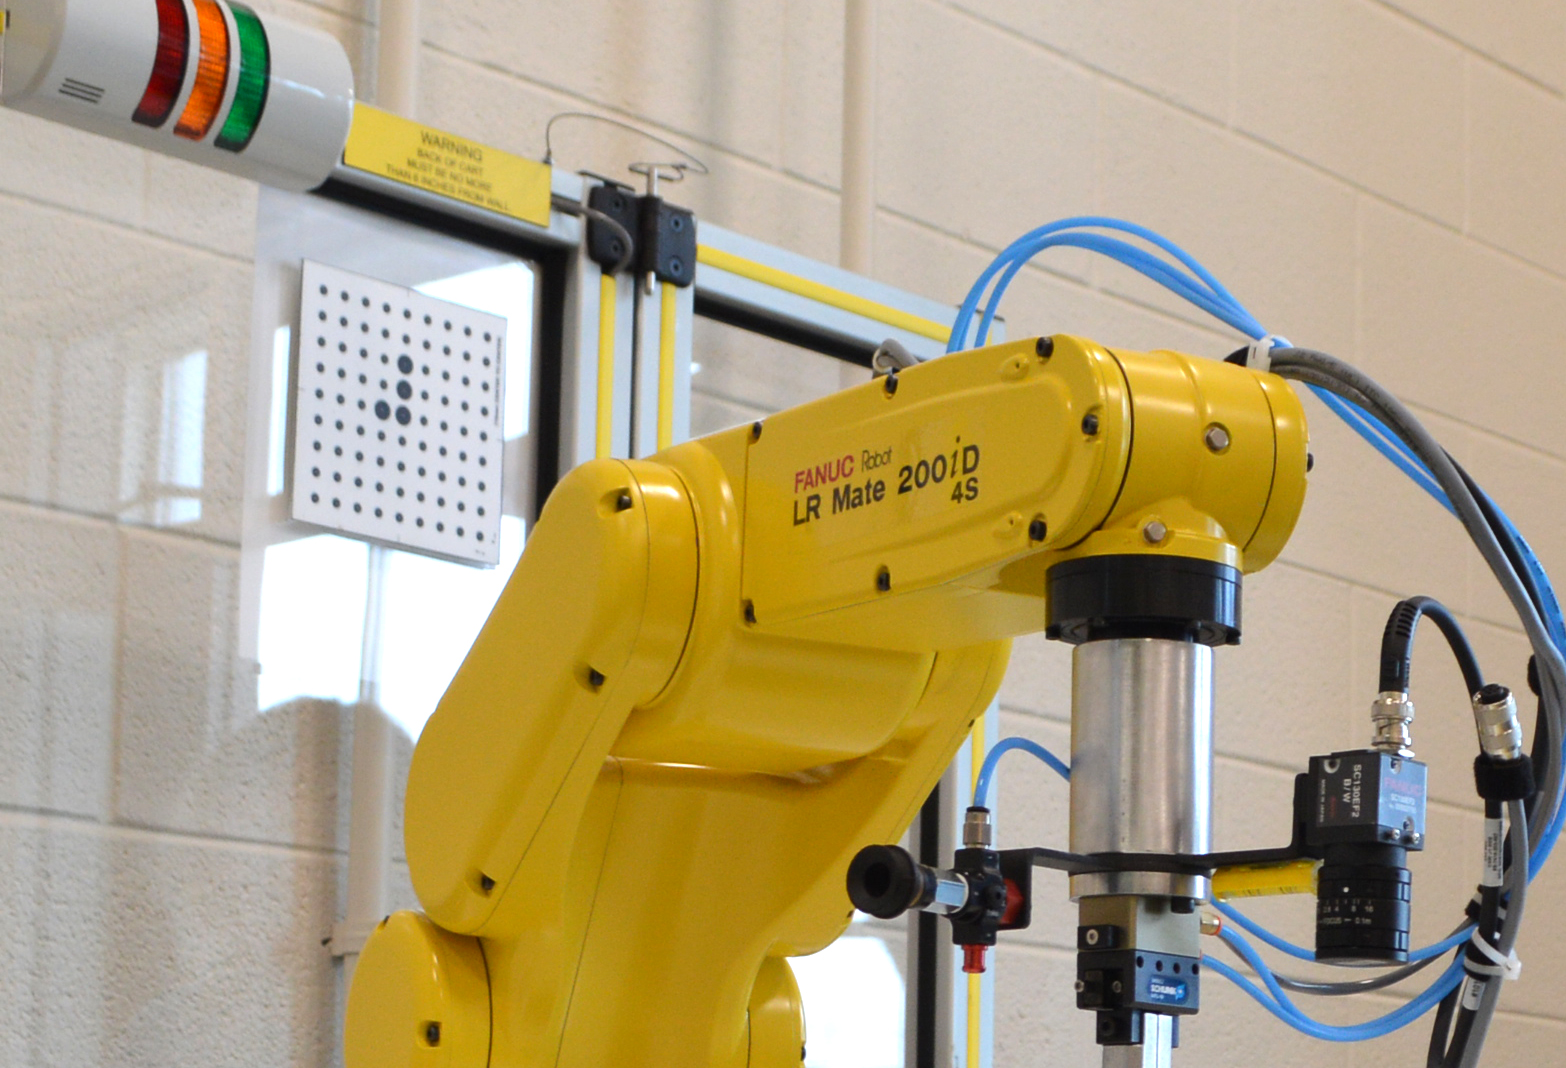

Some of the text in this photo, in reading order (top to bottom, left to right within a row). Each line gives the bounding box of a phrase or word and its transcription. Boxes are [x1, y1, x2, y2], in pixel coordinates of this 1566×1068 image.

[416, 147, 441, 163] BACK
[459, 159, 485, 176] CART
[420, 130, 483, 162] WARNING
[386, 163, 411, 180] THAN
[421, 176, 456, 195] INCHES
[458, 186, 485, 203] FROM
[487, 196, 510, 212] WALL
[406, 157, 492, 192] MUST BE NO MORE
[793, 435, 981, 527] LR Mate 200iD
[794, 446, 893, 494] FANUC Robot
[950, 476, 980, 504] 4S
[1351, 763, 1363, 819] SC130EF2
